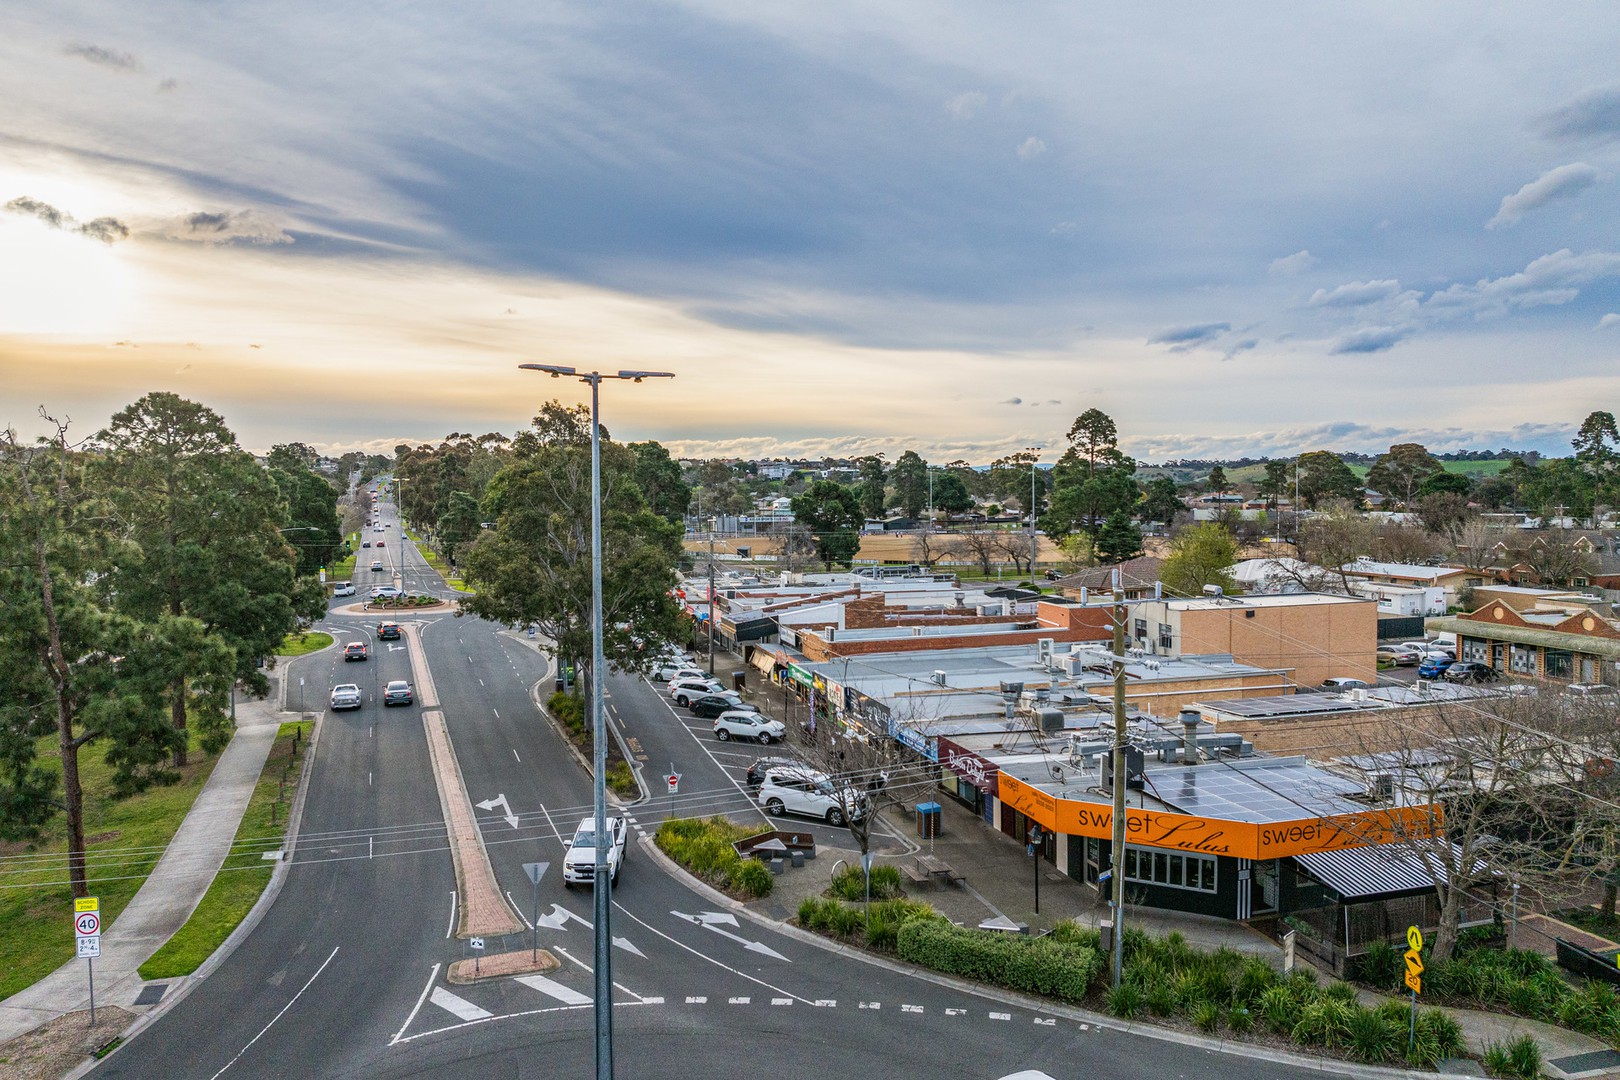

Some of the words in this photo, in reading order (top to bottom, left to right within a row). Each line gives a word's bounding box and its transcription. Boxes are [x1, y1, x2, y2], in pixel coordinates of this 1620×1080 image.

[1079, 810, 1152, 833] swet
[1262, 820, 1322, 846] sweet
[1129, 816, 1231, 852] Lulus
[79, 919, 96, 929] 40
